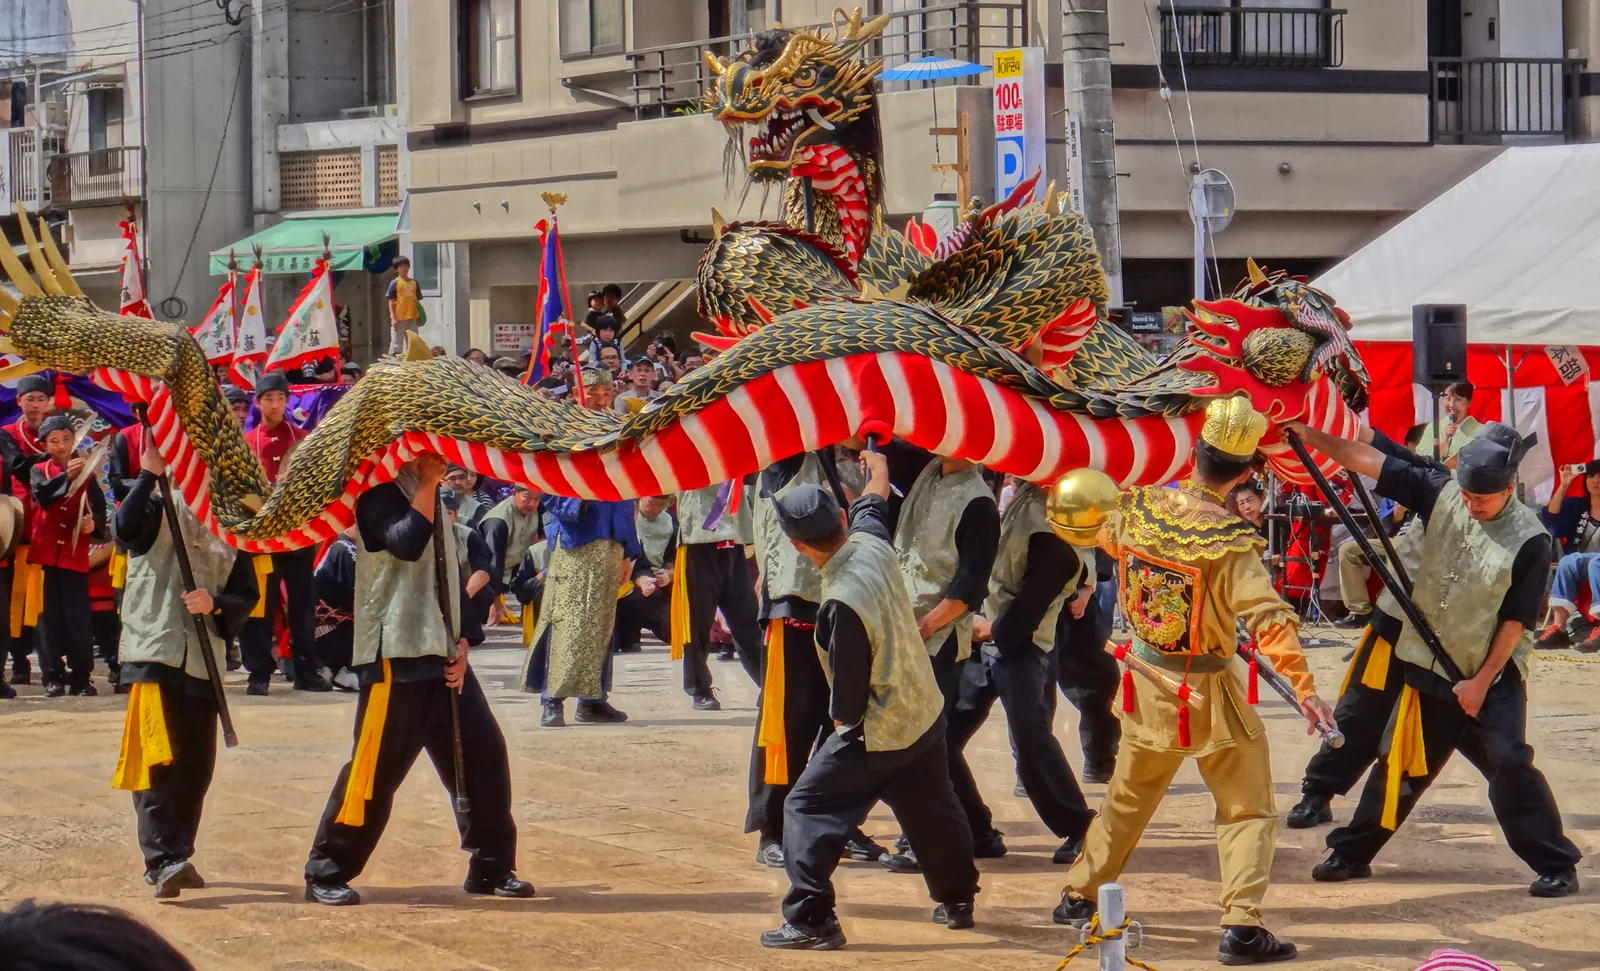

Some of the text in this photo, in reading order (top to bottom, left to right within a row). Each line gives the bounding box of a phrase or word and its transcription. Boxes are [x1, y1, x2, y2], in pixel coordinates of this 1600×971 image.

[996, 57, 1020, 74] TOP24
[996, 113, 1023, 131] 駐車場
[997, 140, 1022, 204] P
[1551, 345, 1581, 379] 本部
